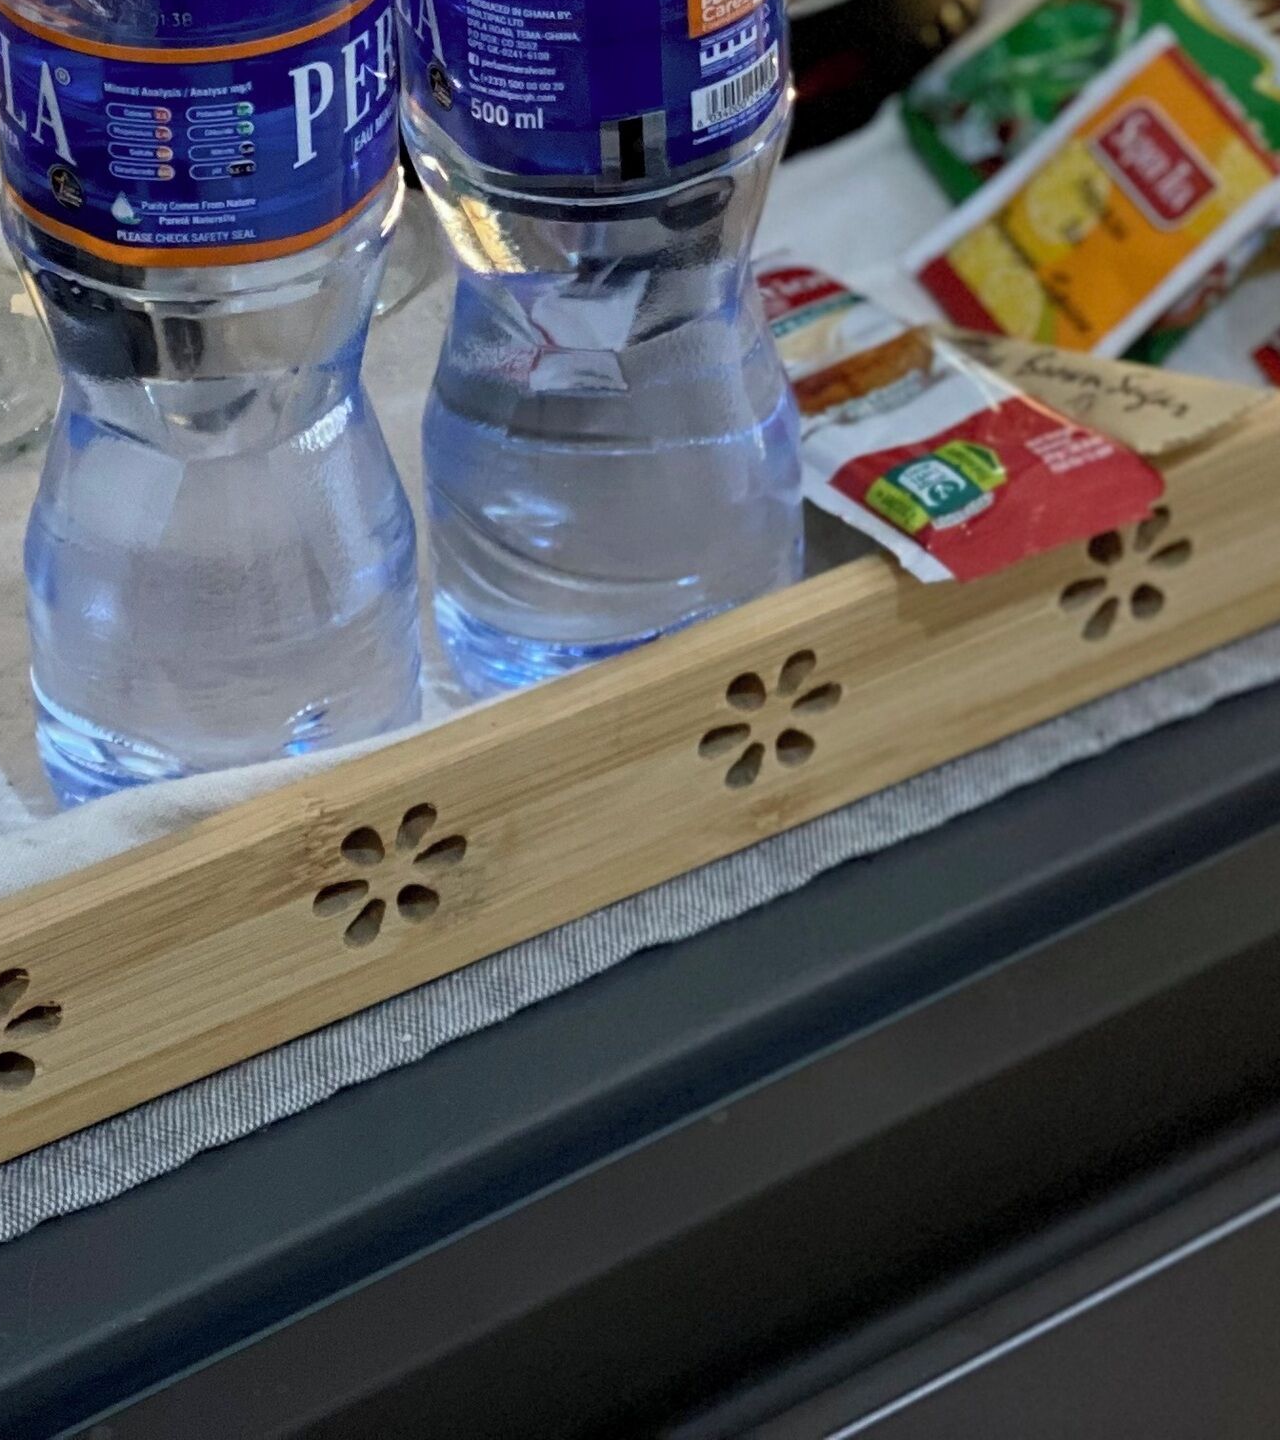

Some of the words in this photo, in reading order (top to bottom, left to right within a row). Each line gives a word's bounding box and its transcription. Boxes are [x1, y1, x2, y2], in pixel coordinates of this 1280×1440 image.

[523, 9, 555, 20] GHANA
[471, 97, 509, 127] 500
[515, 106, 543, 129] ml
[116, 230, 154, 243] PLEASE
[155, 232, 190, 243] CHECK
[191, 231, 229, 243] SAFETY
[232, 229, 257, 240] SEAL
